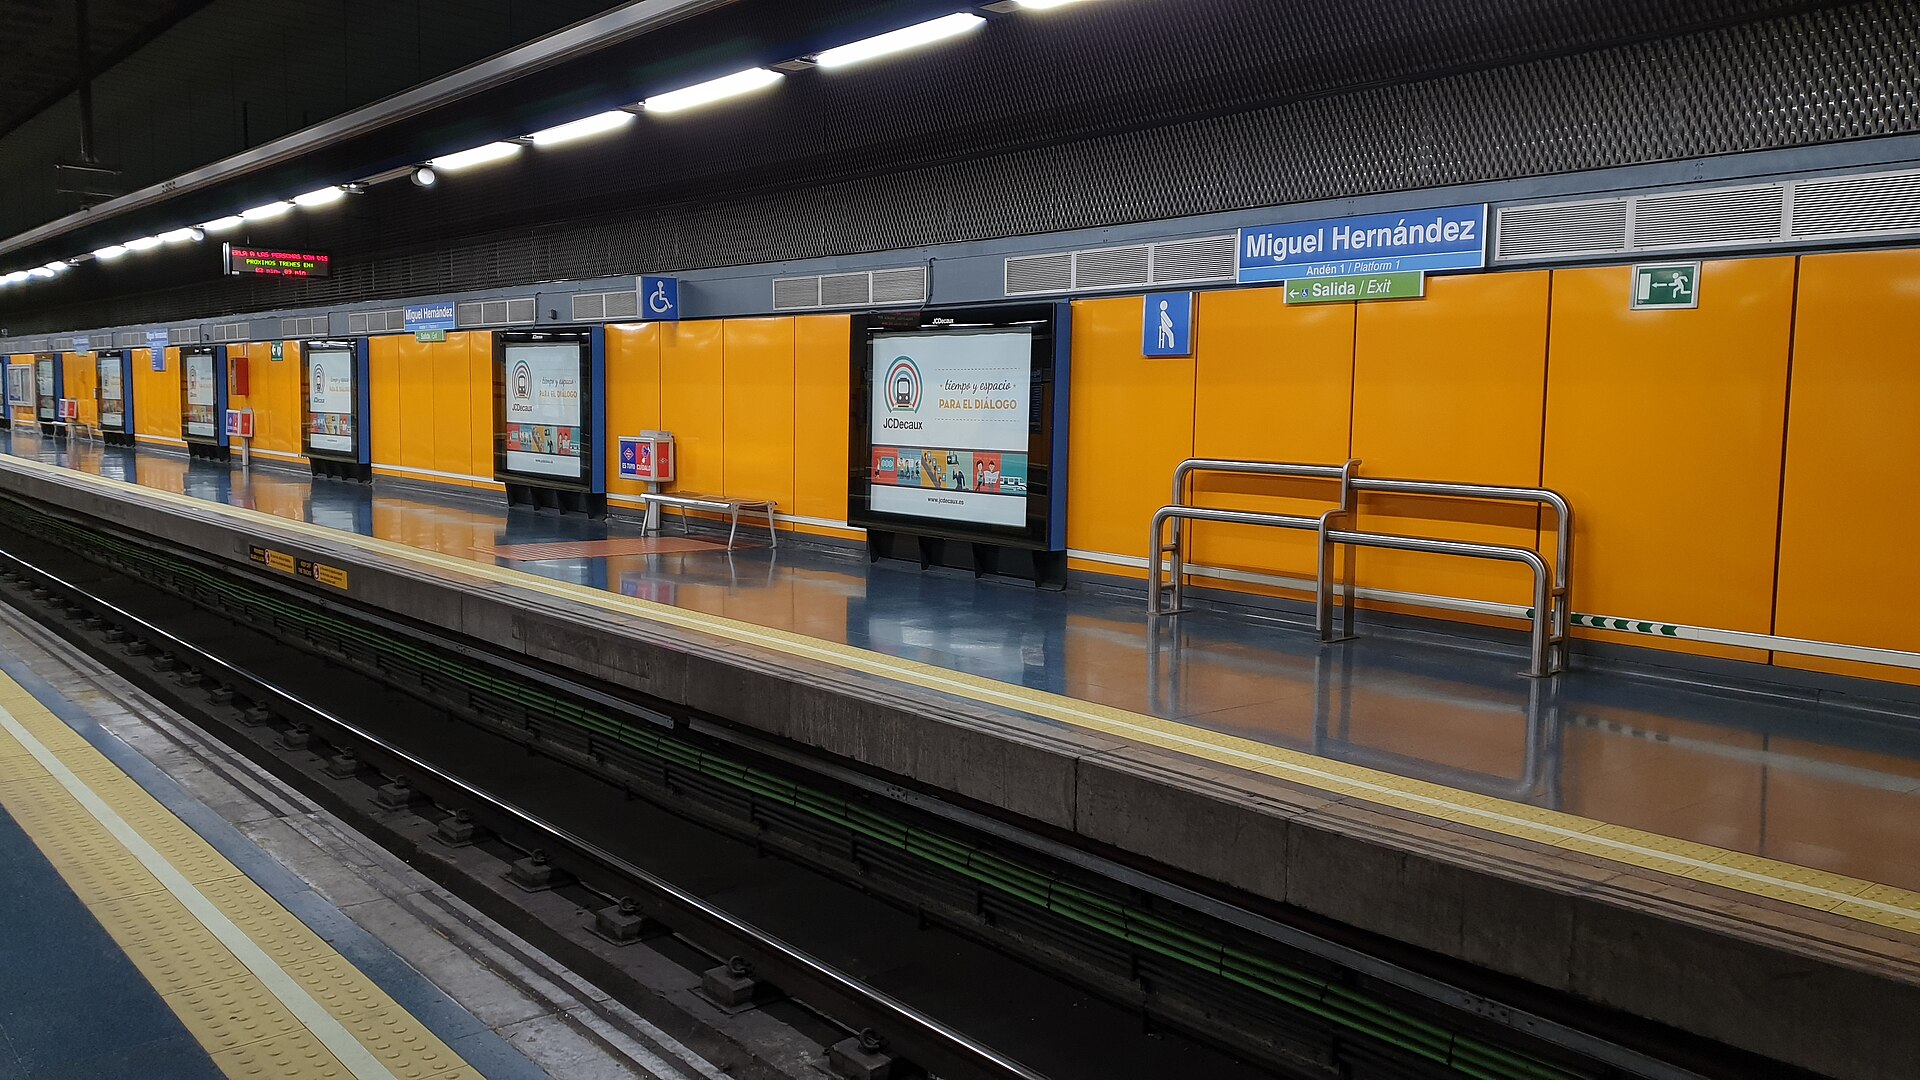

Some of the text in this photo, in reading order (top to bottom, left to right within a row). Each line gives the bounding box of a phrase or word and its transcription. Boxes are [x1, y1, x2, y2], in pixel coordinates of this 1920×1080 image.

[1246, 217, 1476, 262] Miguel Hernández
[246, 258, 276, 266] PROXIMOS
[1306, 259, 1400, 276] Andén 1 / Platform 1
[1312, 279, 1392, 298] Salida / Exit
[406, 306, 452, 322] Miguel Hernández
[944, 379, 1011, 394] tiempo y espacio
[939, 396, 1018, 410] PARA EL DIÁLOGO
[883, 418, 923, 430] JCDecaux
[928, 497, 964, 505] www.jcdecaux.es
